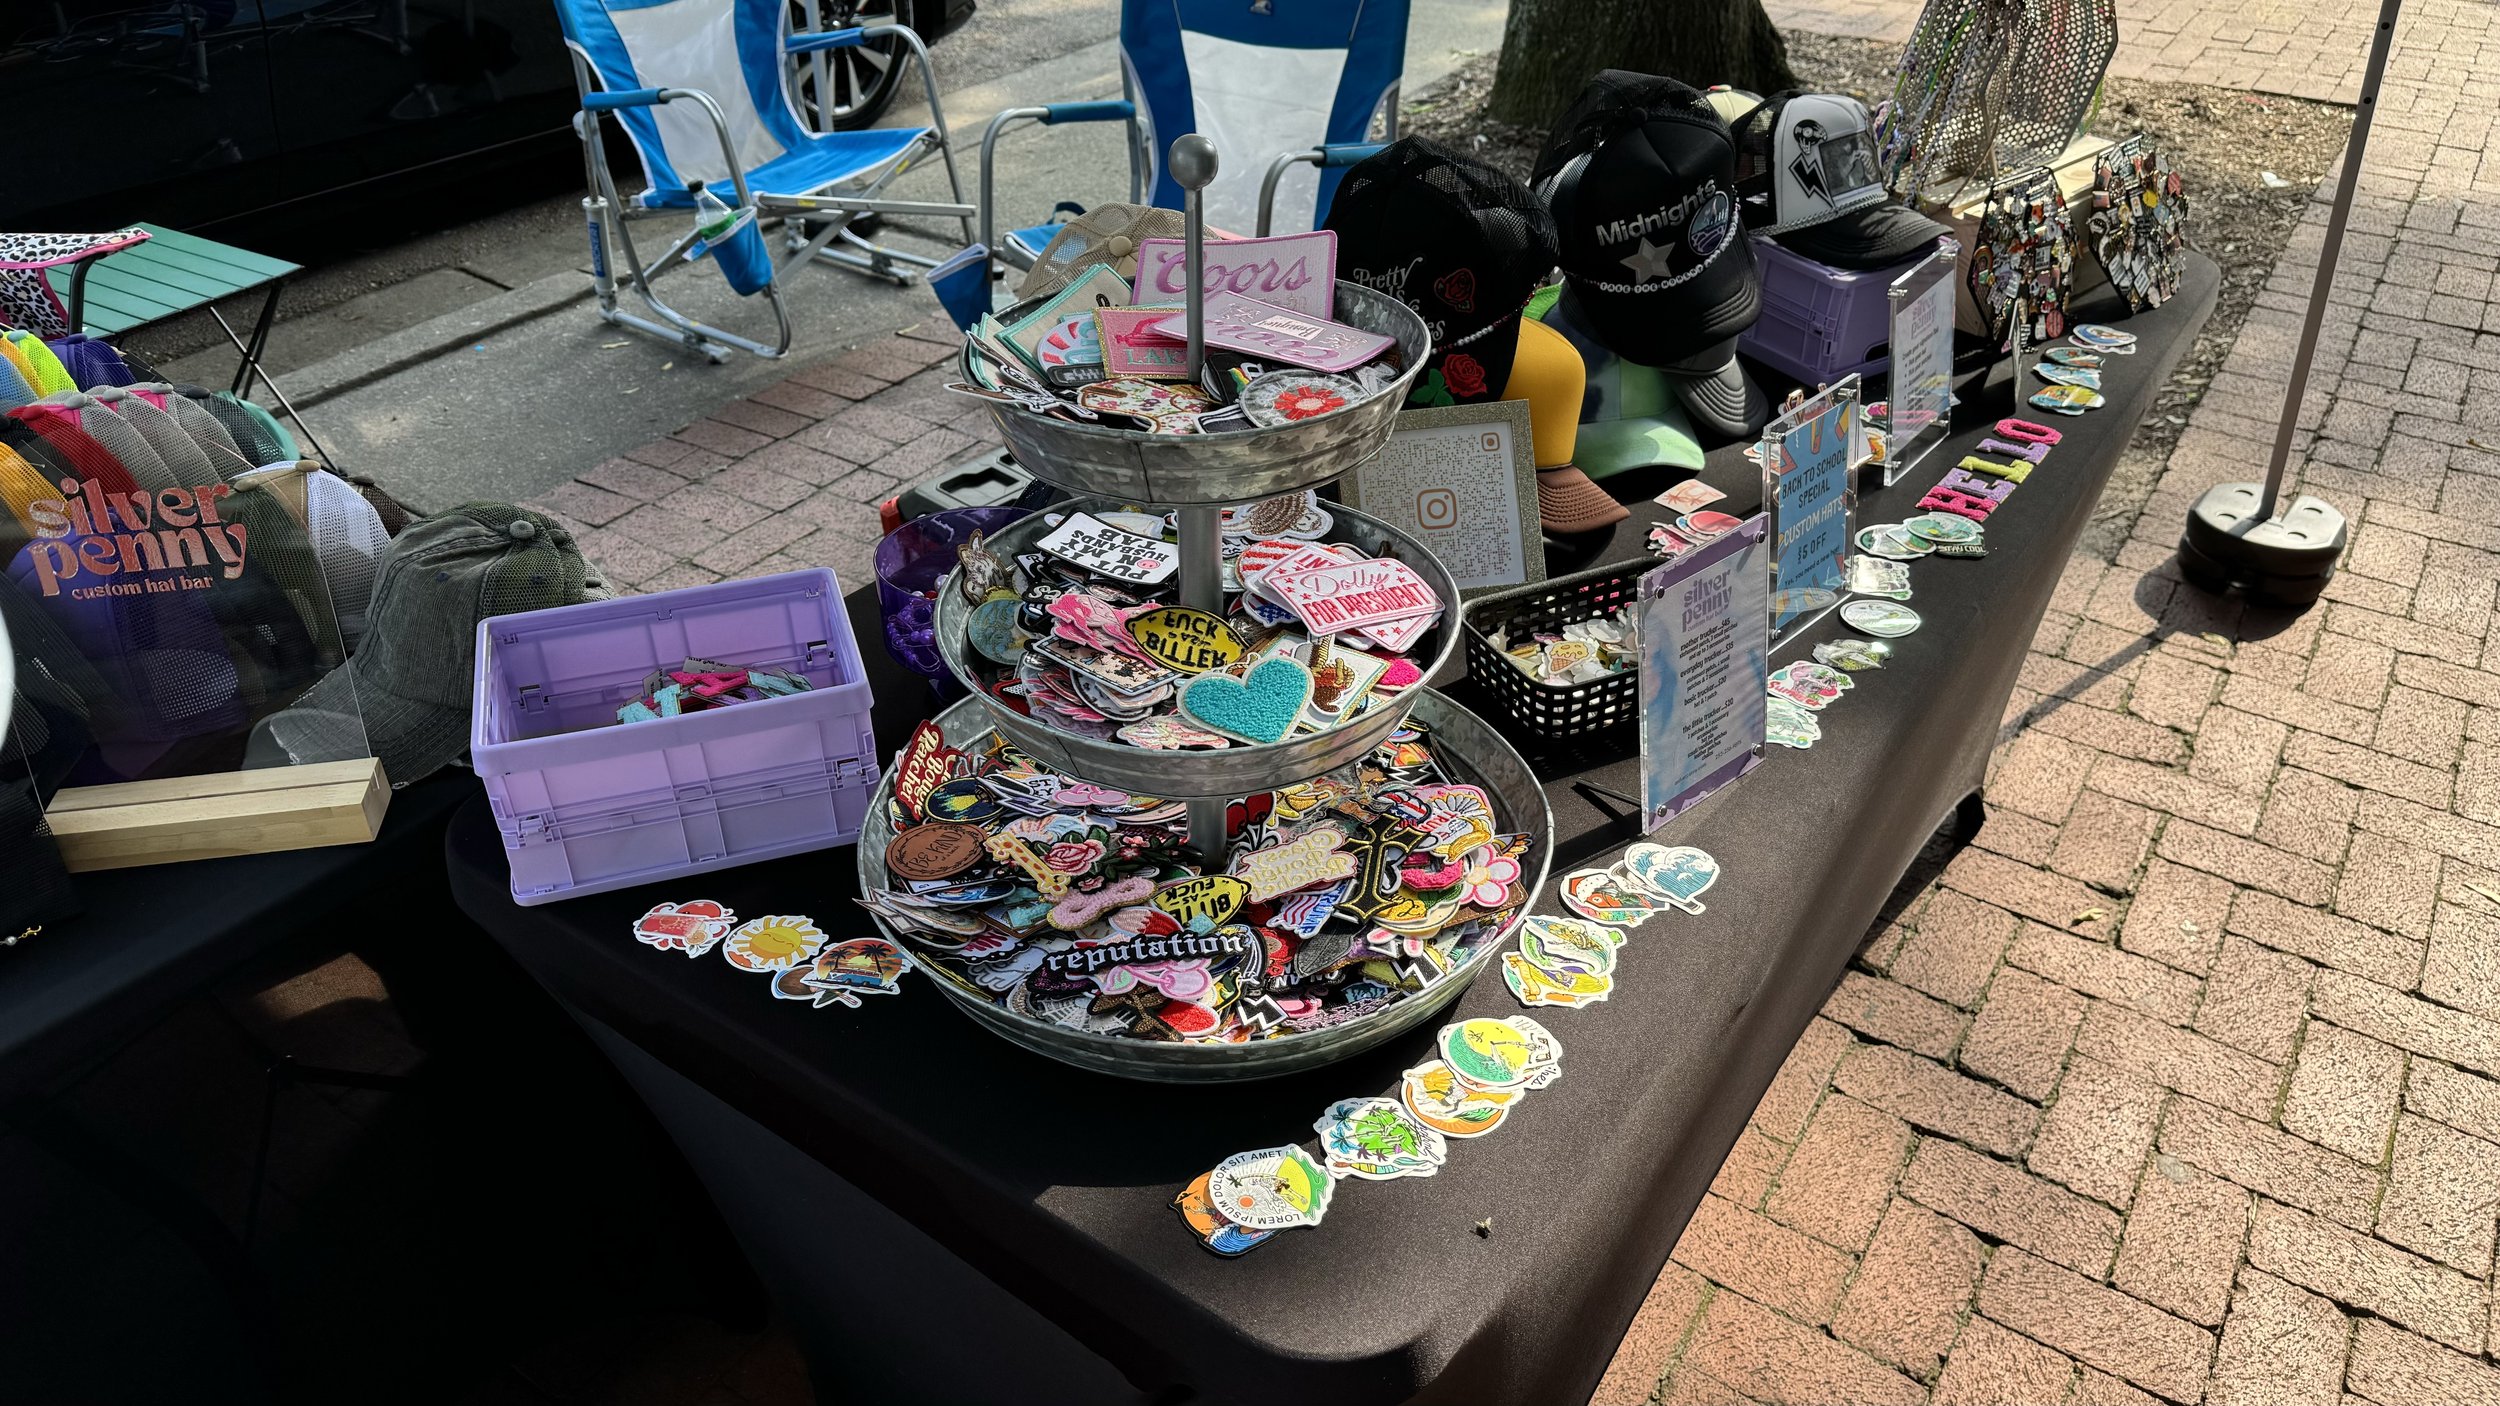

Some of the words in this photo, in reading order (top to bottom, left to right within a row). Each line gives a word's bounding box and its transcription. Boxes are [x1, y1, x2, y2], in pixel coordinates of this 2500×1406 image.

[1596, 179, 1716, 246] Midnights
[1157, 249, 1312, 294] Coors
[1353, 257, 1423, 289] Pretty
[1782, 478, 1802, 499] BACK
[1803, 466, 1815, 486] TO
[1816, 448, 1847, 476] SCHOOL
[1915, 418, 2063, 522] HELLO
[29, 477, 230, 538] silver
[1798, 479, 1830, 509] SPECIAL
[1784, 509, 1820, 547] CUSTOM
[1820, 495, 1843, 522] HATS
[1051, 548, 1085, 561] IT
[1060, 538, 1109, 558] MY
[1072, 530, 1170, 562] HUSBANDS
[1098, 528, 1157, 550] TAB
[1797, 546, 1808, 564] $5
[1810, 531, 1827, 554] OFF
[27, 523, 247, 597] penny
[1090, 560, 1151, 580] PUT
[71, 580, 146, 600] custom
[147, 573, 176, 593] hat
[180, 575, 213, 591] bar
[1300, 569, 1390, 597] Dolly
[1684, 569, 1730, 608] silver
[1302, 599, 1346, 627] FOR
[1335, 582, 1432, 618] PRESIDENT
[1682, 586, 1732, 633] penny
[1681, 634, 1699, 651] mother
[1682, 724, 1691, 734] the
[1692, 717, 1703, 729] little
[901, 726, 939, 808] Ratchet
[1165, 877, 1215, 902] FUCK
[1168, 893, 1231, 928] BITTE
[1047, 932, 1246, 972] reputation
[1228, 1155, 1246, 1167] SIT
[1251, 1149, 1282, 1160] AMET
[1212, 1165, 1229, 1198] DOLOR
[1219, 1200, 1252, 1223] IPSUM
[1258, 1213, 1300, 1225] LOREM
